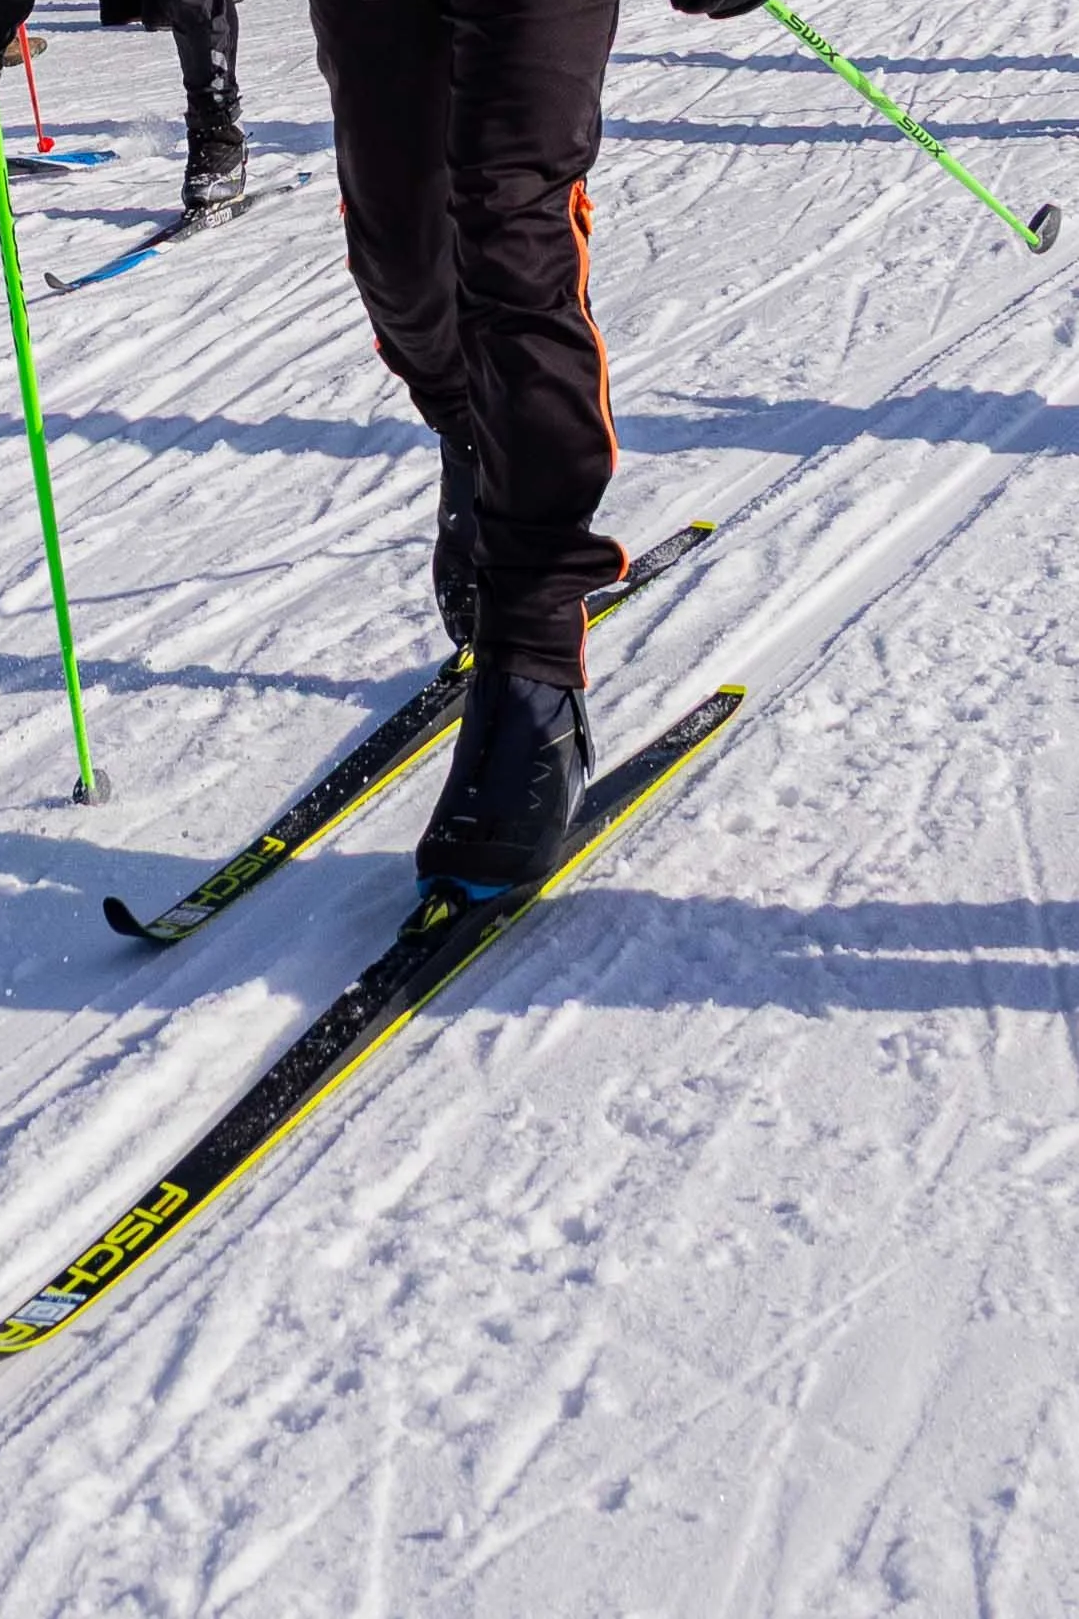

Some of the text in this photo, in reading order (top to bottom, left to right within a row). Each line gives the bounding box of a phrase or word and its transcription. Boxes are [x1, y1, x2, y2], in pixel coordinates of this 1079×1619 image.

[784, 14, 841, 63] SWIX
[897, 115, 945, 159] SWIX
[147, 835, 286, 935] FISCH
